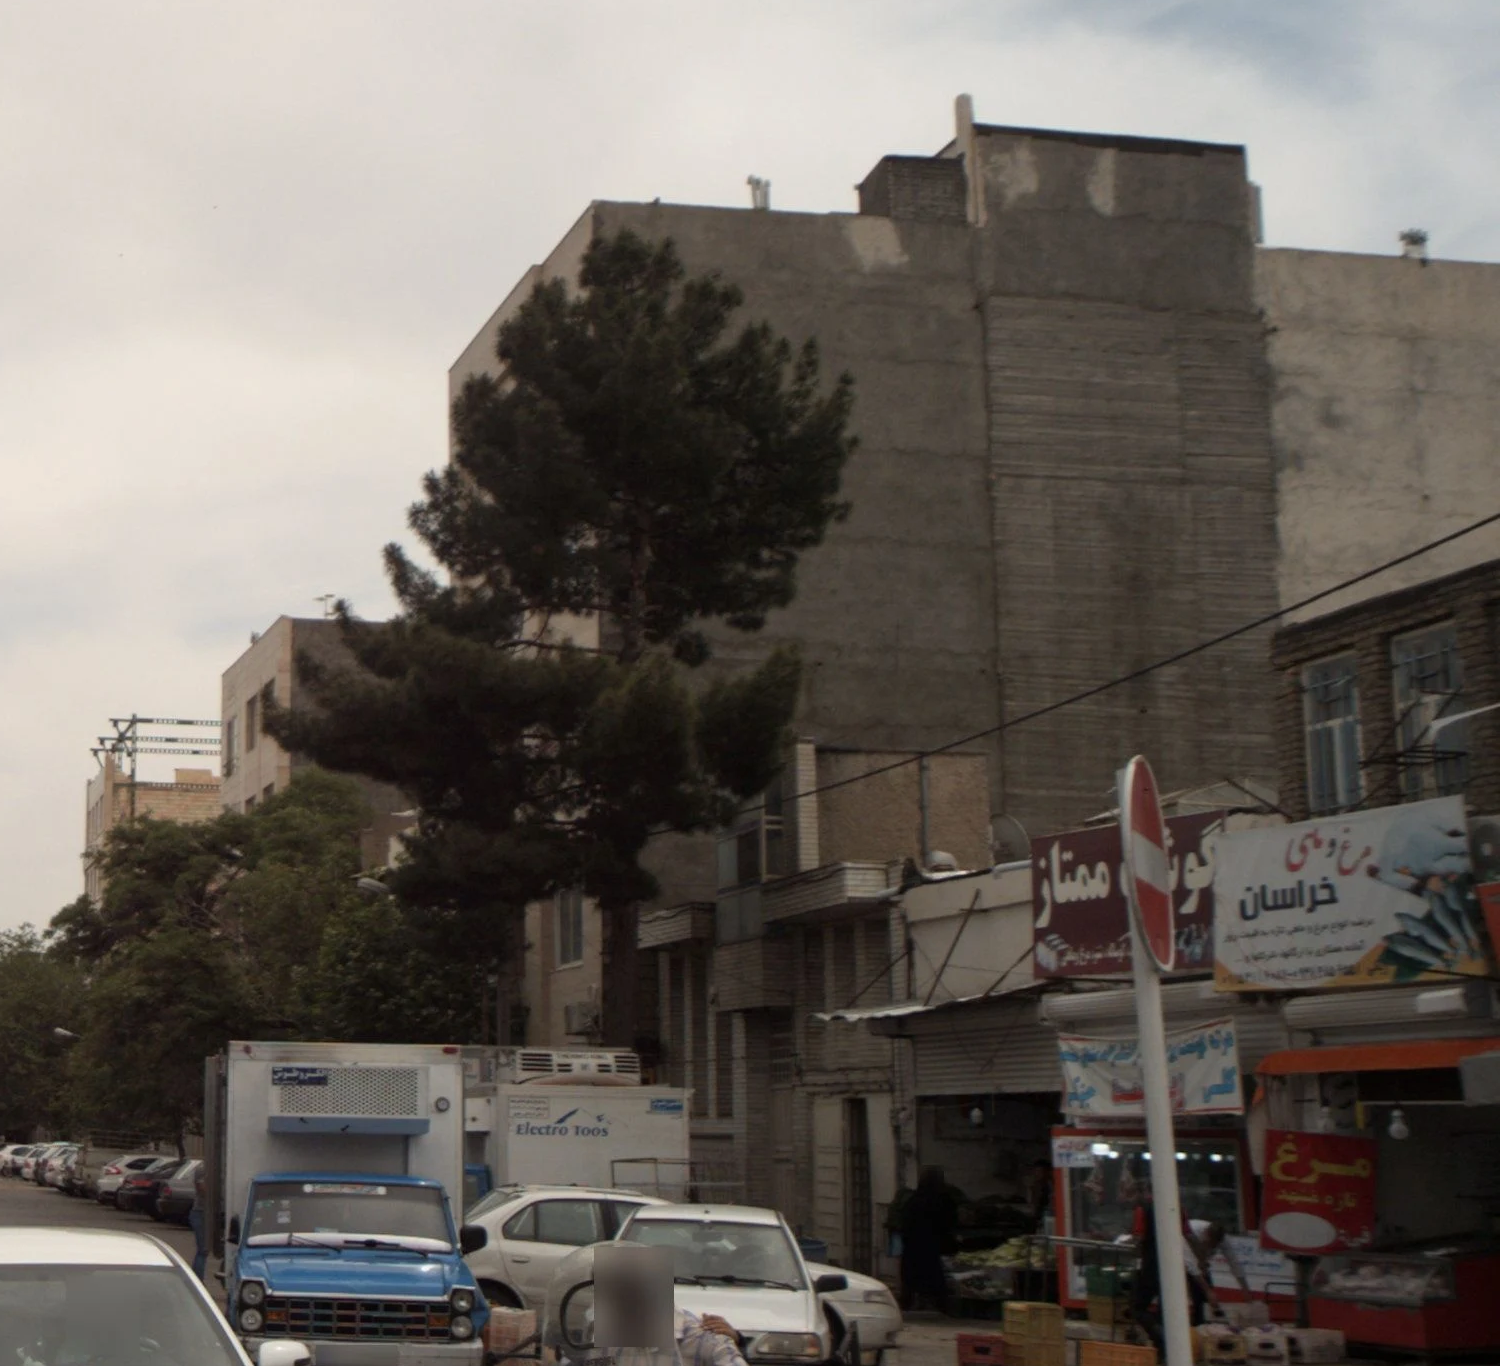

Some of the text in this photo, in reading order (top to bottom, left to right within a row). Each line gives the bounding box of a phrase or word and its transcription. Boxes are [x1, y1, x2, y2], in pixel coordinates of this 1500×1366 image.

[1033, 839, 1113, 929] ممتاز
[1238, 876, 1339, 922] خراسان
[515, 1121, 609, 1137] Electro Toos
[1269, 1133, 1372, 1184] مرغ
